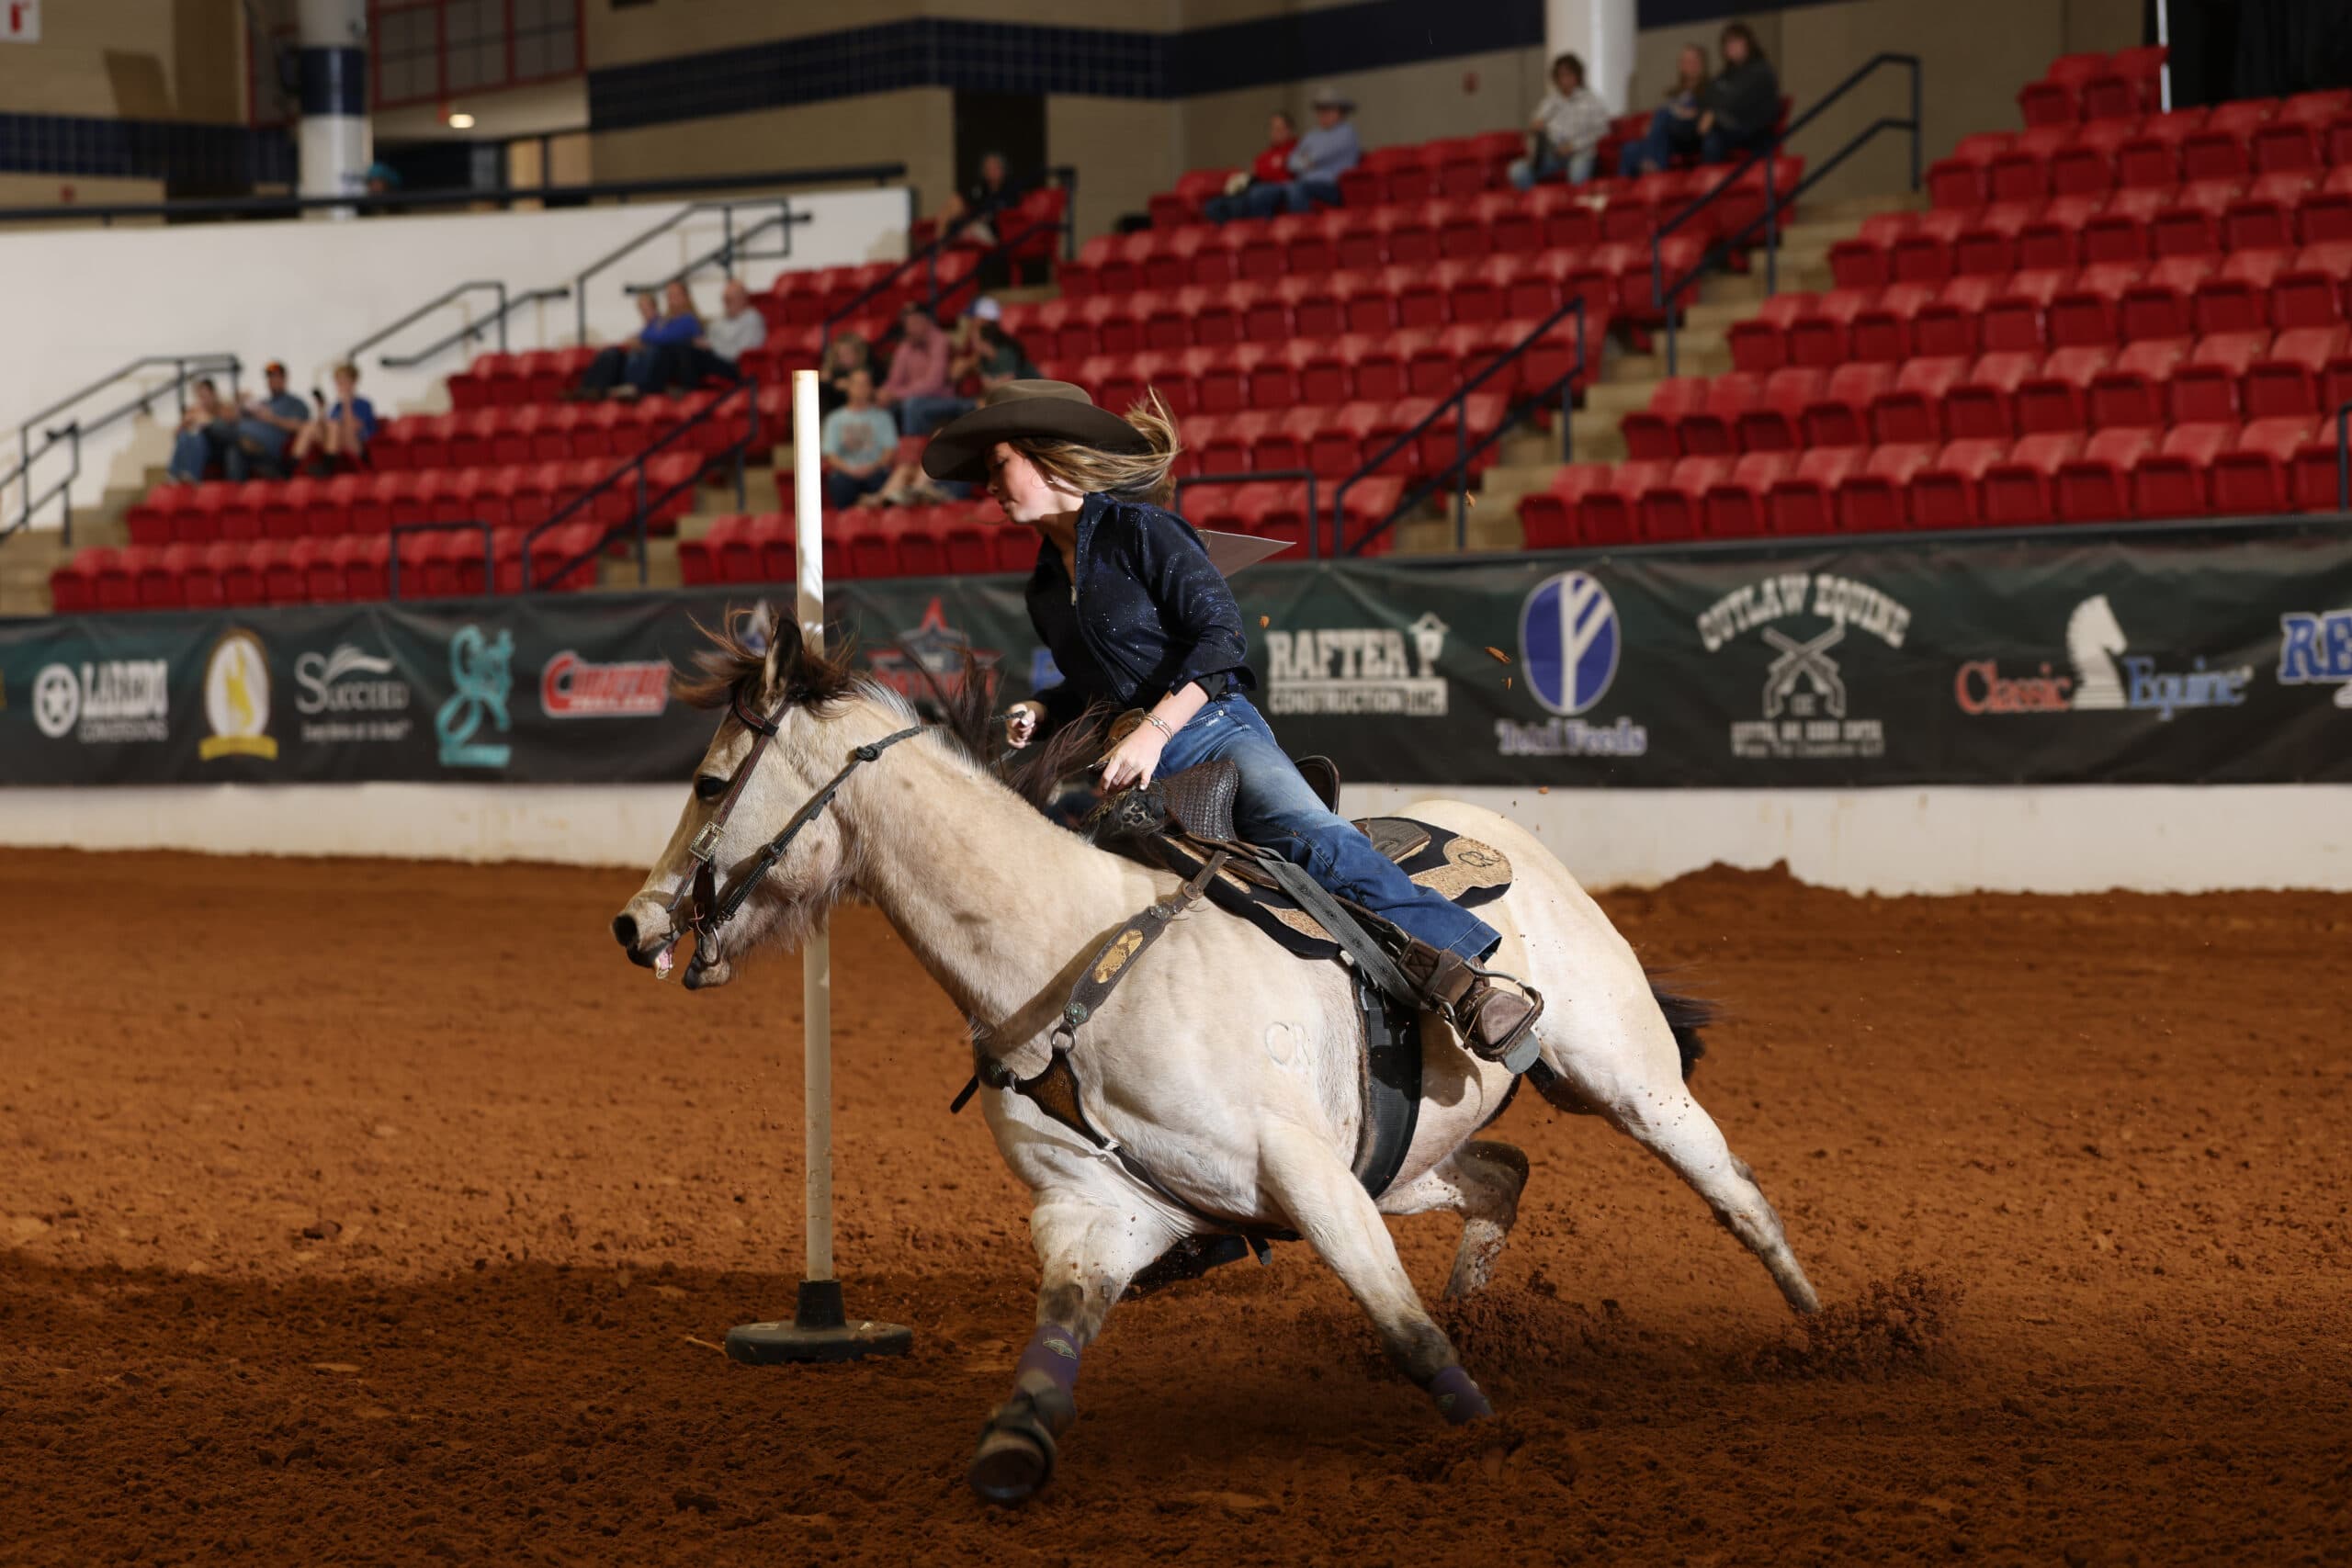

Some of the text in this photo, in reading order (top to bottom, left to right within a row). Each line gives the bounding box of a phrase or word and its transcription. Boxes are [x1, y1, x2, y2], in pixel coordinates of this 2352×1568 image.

[1698, 573, 1911, 651] OUTLAW EQUINE
[1265, 628, 1410, 678] RAFTER
[1268, 690, 1408, 715] CONSTRUCTION
[1955, 656, 2245, 722] Classic Equine
[1495, 716, 1647, 756] Total Feeds
